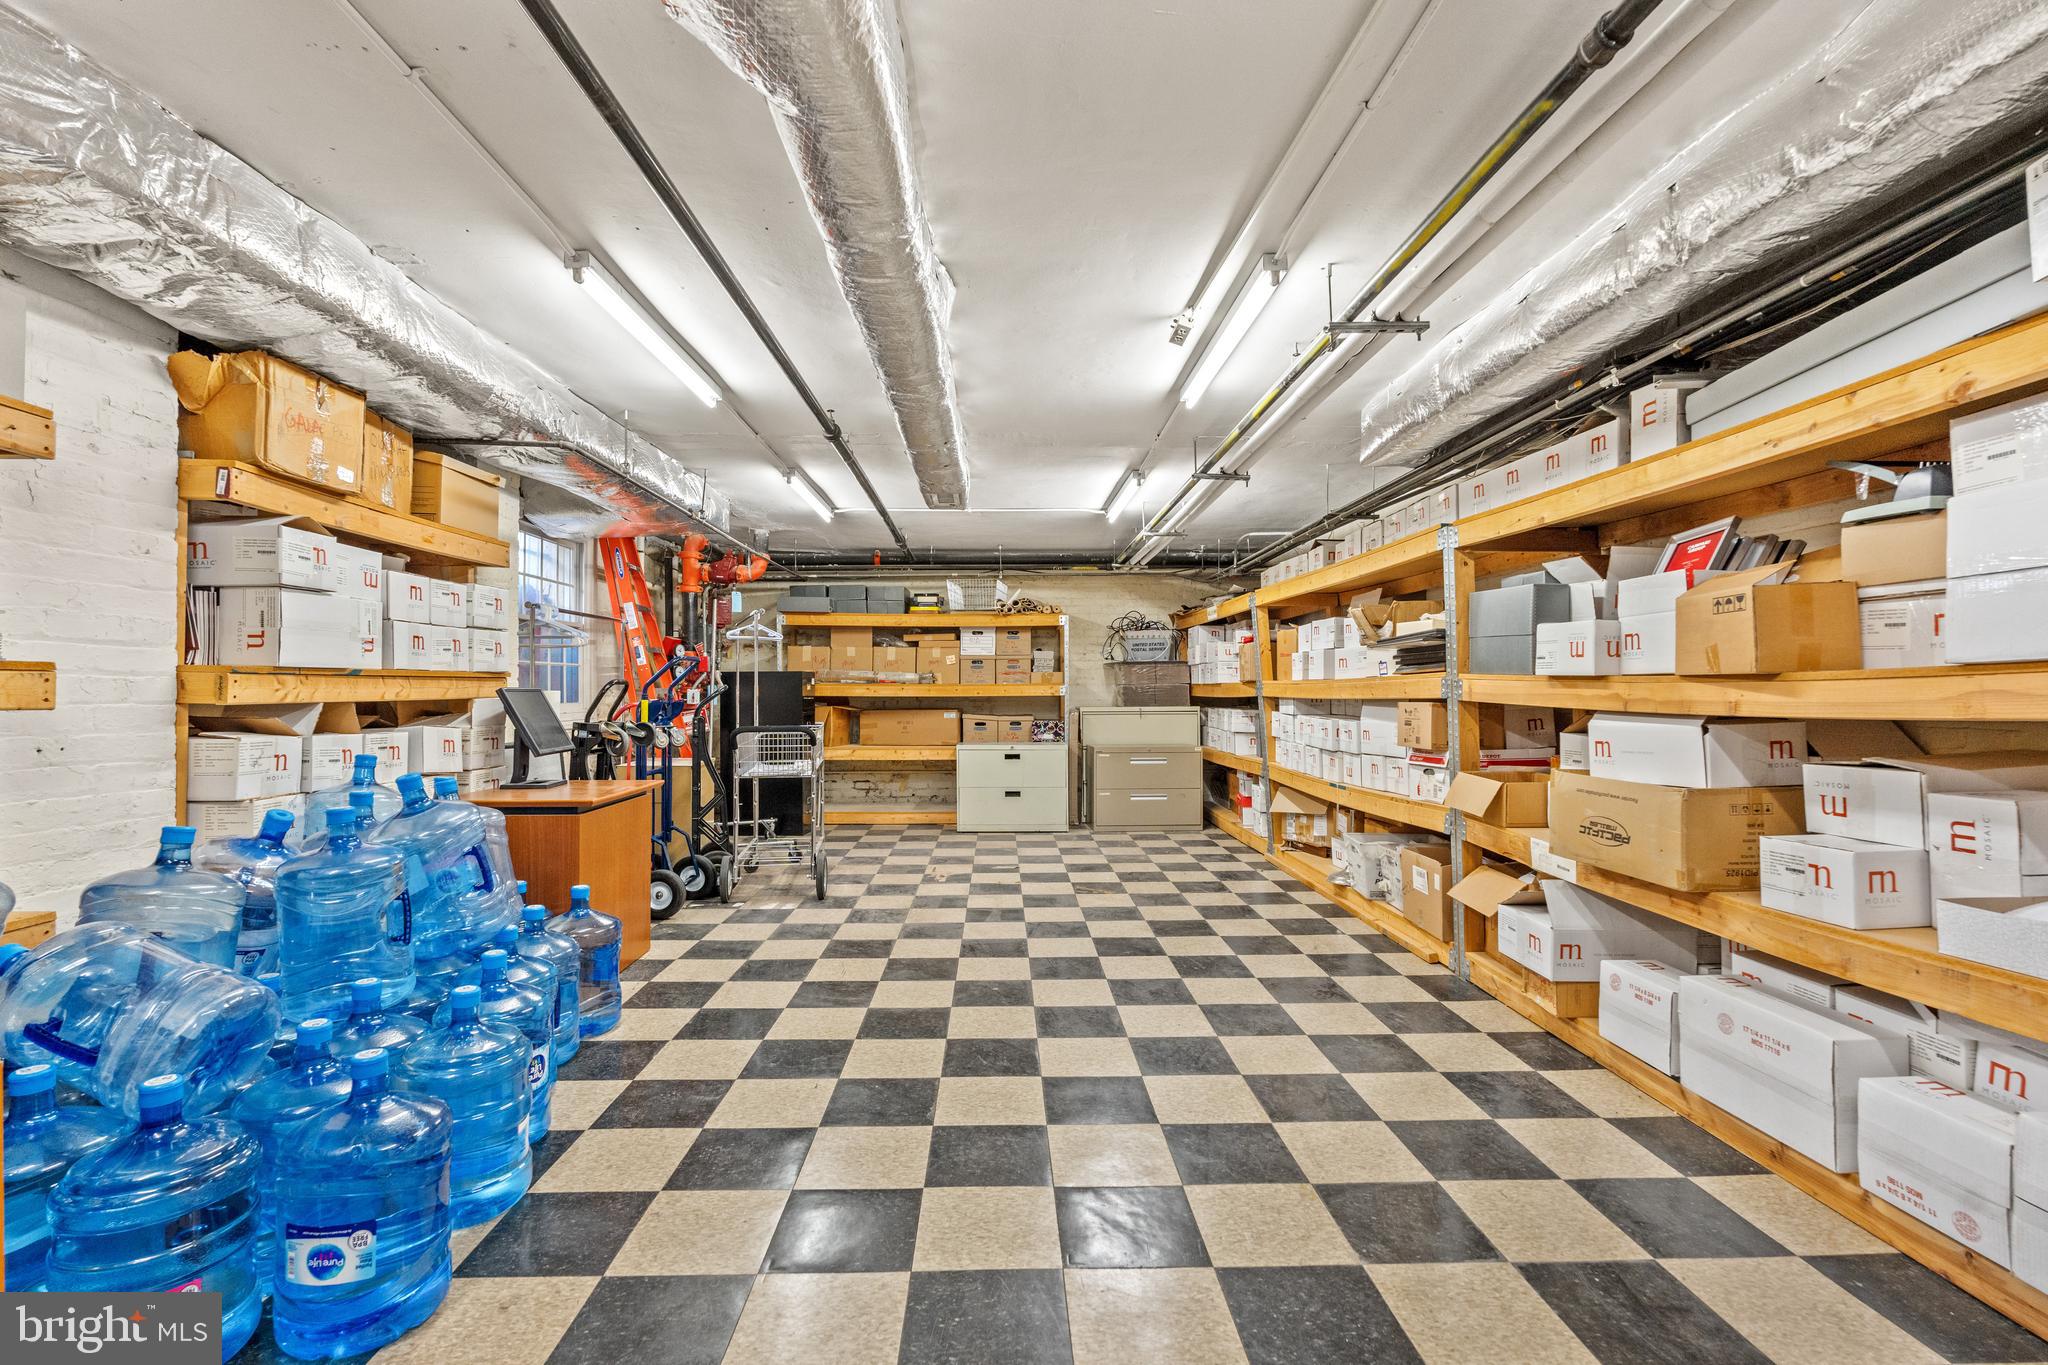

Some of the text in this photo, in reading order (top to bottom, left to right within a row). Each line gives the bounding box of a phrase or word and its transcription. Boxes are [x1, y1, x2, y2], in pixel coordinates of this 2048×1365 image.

[1591, 434, 1607, 454] m
[1546, 452, 1560, 471] m
[1507, 468, 1519, 486] m
[1624, 633, 1642, 650] m
[1528, 718, 1544, 731] m
[1594, 740, 1612, 758] m
[1770, 740, 1794, 760] m
[1814, 781, 1850, 789] MOSAIC
[1820, 794, 1847, 818] m
[1950, 820, 1976, 854] m
[1983, 816, 1992, 861] MOSAIC
[1868, 870, 1898, 894] m
[1866, 896, 1903, 904] MOSAIC
[1529, 933, 1542, 954] m
[1560, 944, 1583, 960] m
[1750, 1028, 1759, 1038] 1/4
[1988, 1060, 2029, 1100] m
[352, 1234, 368, 1242] FREE
[308, 1257, 344, 1268] Pure Life
